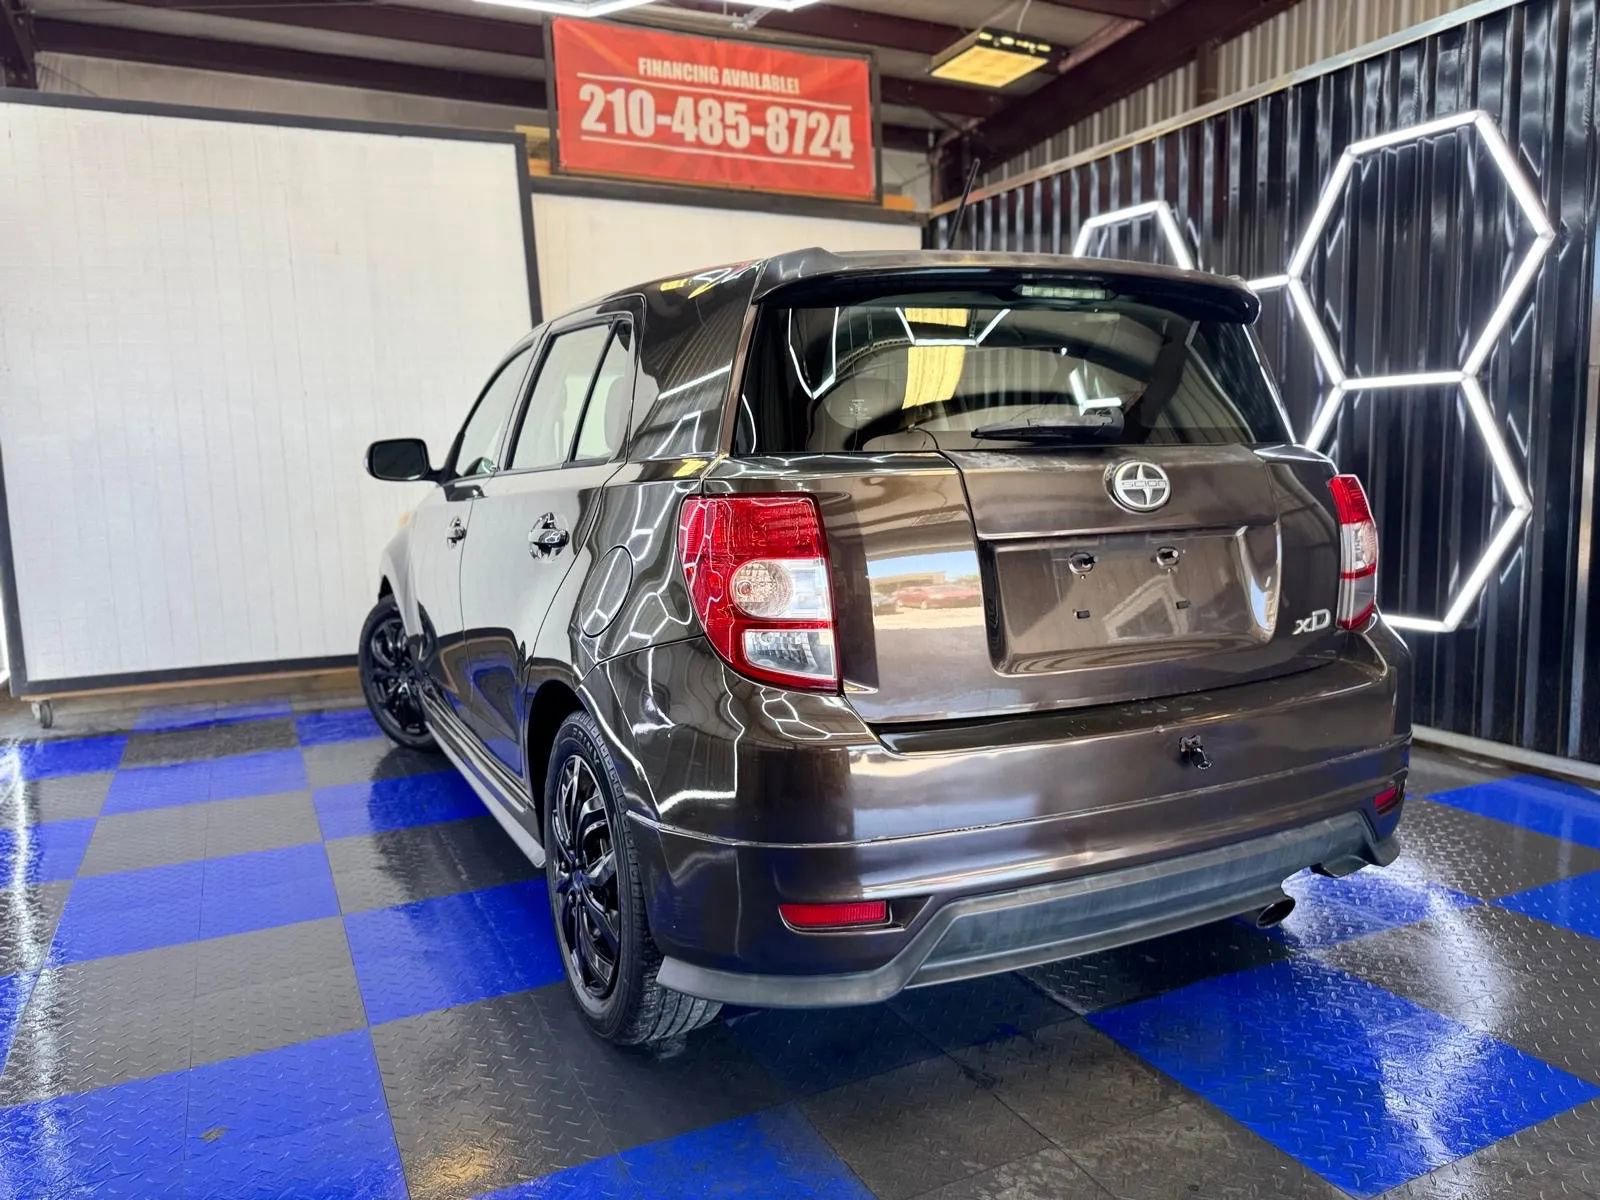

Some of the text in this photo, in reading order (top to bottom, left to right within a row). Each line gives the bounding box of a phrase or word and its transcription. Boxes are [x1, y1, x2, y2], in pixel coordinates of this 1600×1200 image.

[638, 57, 800, 95] FINANCING AVAILABLE!
[579, 83, 854, 160] 210-485-8724
[1292, 608, 1331, 635] xD
